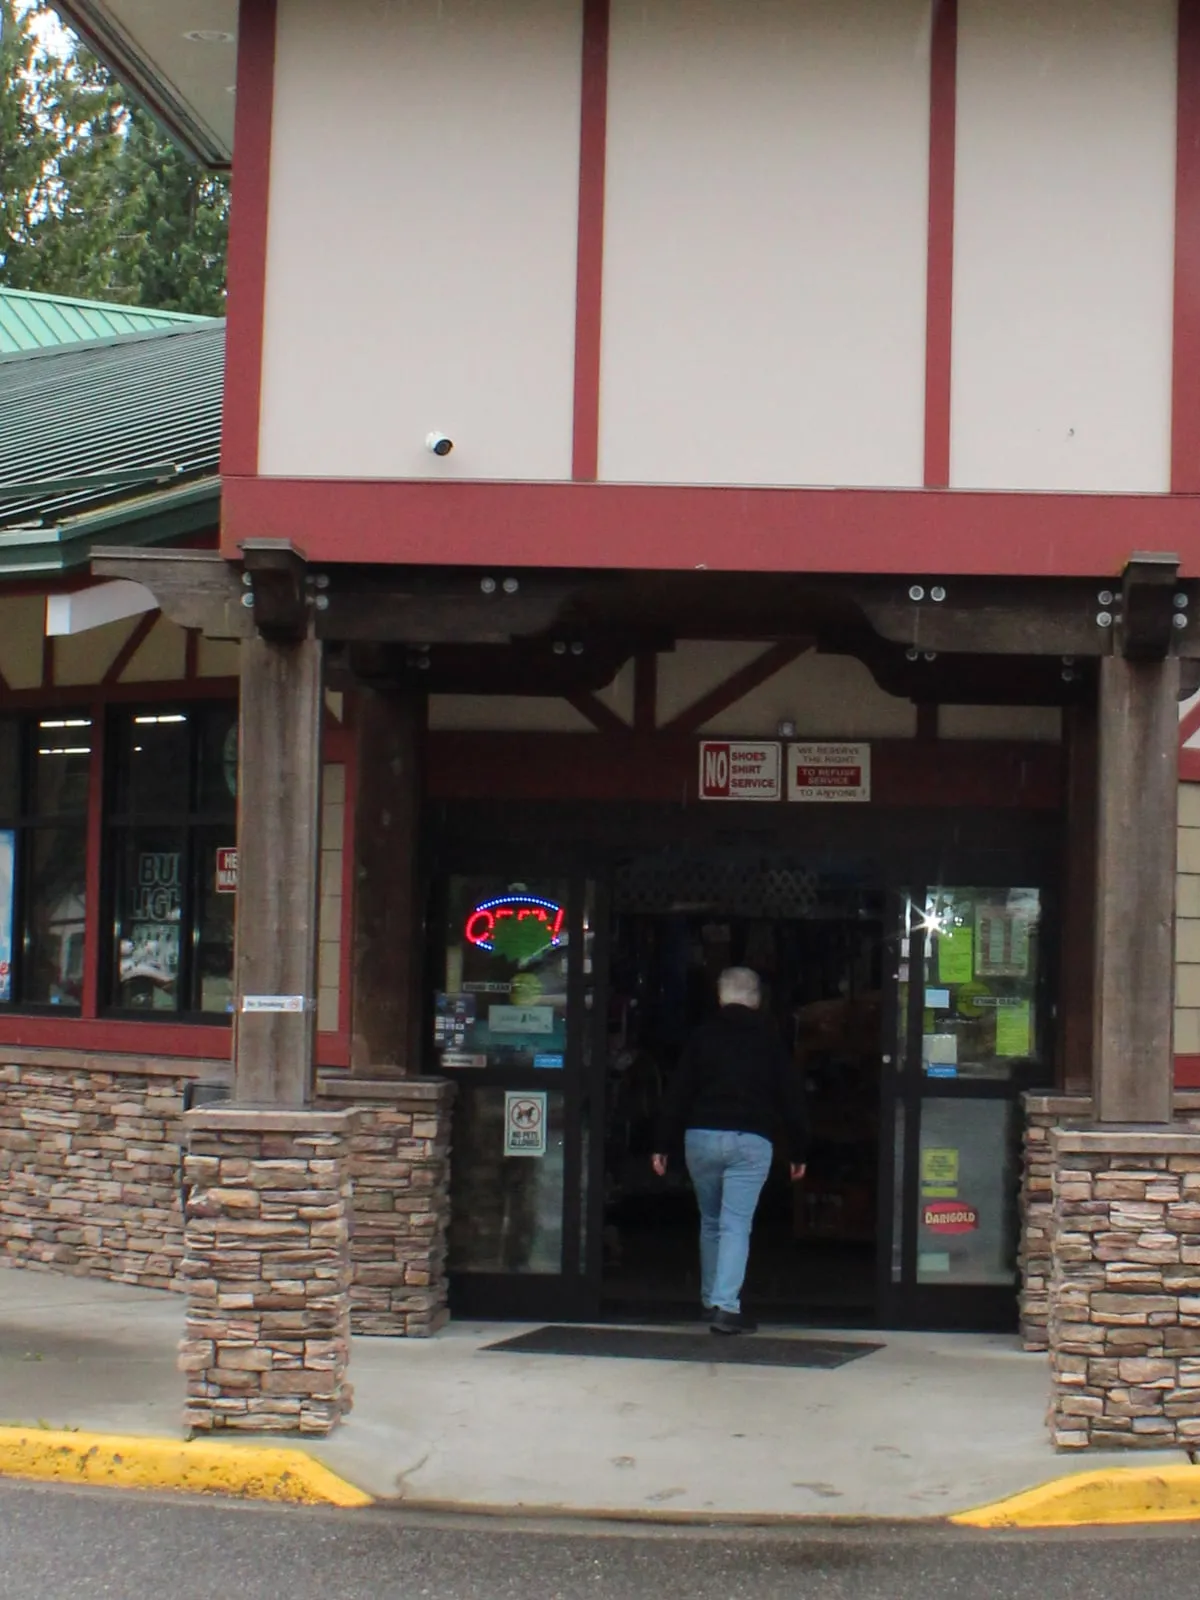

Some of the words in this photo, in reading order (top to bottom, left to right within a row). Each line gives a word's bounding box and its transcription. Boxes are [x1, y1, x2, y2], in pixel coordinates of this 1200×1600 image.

[731, 752, 767, 762] SHOES
[705, 750, 728, 788] NO
[731, 765, 763, 775] SHIRT
[801, 768, 816, 777] TO
[818, 768, 857, 777] REFUSE
[731, 779, 775, 789] SERVICE
[808, 777, 849, 785] SERVICE
[800, 789, 814, 797] TO
[817, 789, 857, 798] ANYONE
[224, 853, 238, 869] HE
[131, 887, 182, 922] LIG
